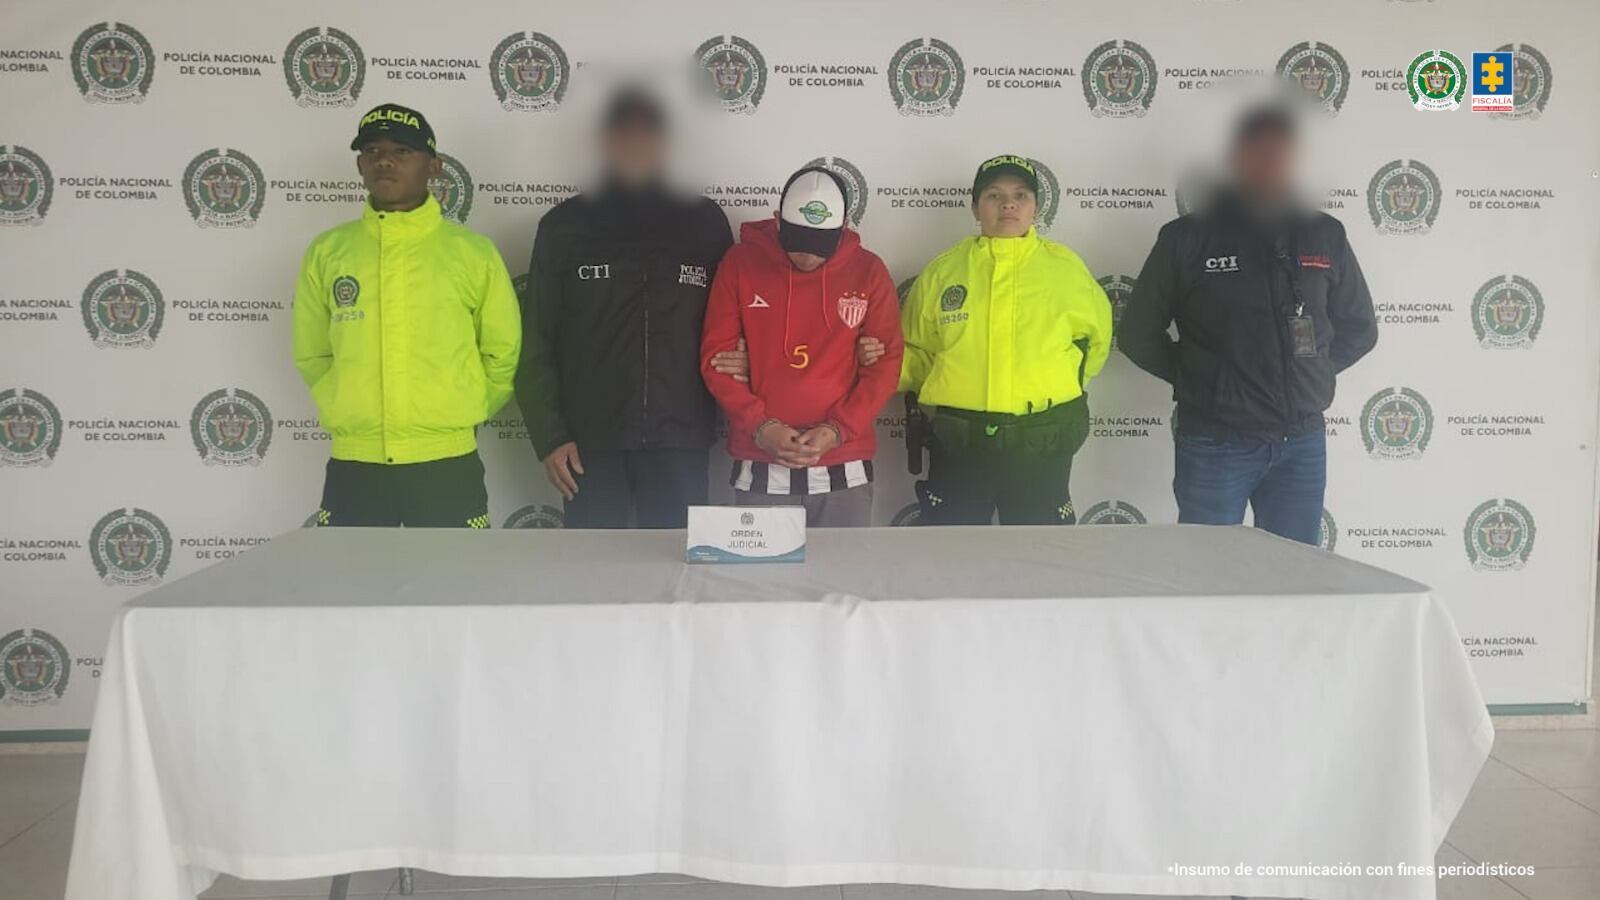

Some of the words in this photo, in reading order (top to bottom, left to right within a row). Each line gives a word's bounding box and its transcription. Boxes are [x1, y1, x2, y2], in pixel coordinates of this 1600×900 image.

[1, 50, 64, 60] NACIONAL
[164, 52, 210, 62] POLICÍA
[214, 54, 276, 64] NACIONAL
[371, 56, 416, 68] POLICÍA
[420, 58, 481, 69] NACIONAL
[0, 63, 49, 72] LOMBIA
[180, 66, 195, 75] DE
[198, 66, 261, 76] COLOMBIA
[774, 64, 817, 74] POLICÍA
[820, 65, 879, 75] NACIONAL
[973, 65, 1016, 76] POLICÍA
[1019, 67, 1076, 76] NACIONAL
[1165, 66, 1208, 77] POLICÍA
[387, 71, 402, 80] DE
[405, 71, 466, 80] COLOMBIA
[1362, 68, 1403, 78] POLICÍA
[789, 78, 803, 86] DE
[806, 78, 864, 87] COLOMBIA
[987, 80, 1001, 88] DE
[1004, 80, 1062, 88] COLOMBIA
[1179, 80, 1192, 90] DE
[1376, 82, 1388, 90] DE
[361, 110, 420, 130] POLICÍA
[60, 174, 106, 187] POLICÍA
[110, 177, 173, 188] NACIONAL
[271, 180, 316, 190] POLICÍA
[478, 182, 524, 192] POLICÍA
[726, 186, 782, 196] NACIONAL
[877, 184, 920, 196] POLICÍA
[1066, 186, 1108, 196] POLICÍA
[1112, 188, 1168, 197] NACIONAL
[76, 190, 92, 200] DE
[94, 190, 157, 200] COLOMBIA
[1329, 188, 1359, 197] ONAL
[1456, 187, 1497, 198] POLICÍA
[1500, 188, 1555, 198] NACIONAL
[286, 193, 301, 202] DE
[306, 193, 366, 202] COLOMBIA
[494, 196, 509, 204] DE
[892, 200, 906, 208] DE
[908, 200, 966, 208] COLOMBIA
[1081, 200, 1094, 208] DE
[1097, 200, 1154, 209] COLOMBIA
[1469, 200, 1482, 210] DE
[1486, 200, 1540, 210] COLOMBIA
[1206, 256, 1238, 268] CTI
[578, 264, 610, 280] CTI
[10, 299, 73, 308] NACIONAL
[172, 298, 220, 309] POLICÍA
[222, 300, 284, 310] NACIONAL
[1398, 303, 1454, 312] NACIONAL
[188, 312, 204, 322] DE
[208, 312, 270, 322] COLOMBIA
[1384, 315, 1440, 324] COLOMBIA
[790, 344, 809, 369] 5
[68, 418, 115, 429] POLICÍA
[119, 420, 181, 429] NACIONAL
[1108, 418, 1164, 426] NACIONAL
[1448, 414, 1489, 424] POLICÍA
[1492, 416, 1545, 425] NACIONAL
[294, 432, 309, 440] DE
[498, 432, 513, 440] DE
[890, 430, 905, 438] DE
[1093, 430, 1149, 438] COLOMBIA
[1460, 428, 1474, 436] DE
[1477, 427, 1532, 436] COLOMBIA
[84, 432, 100, 441] DE
[103, 432, 166, 441] COLOMBIA
[730, 530, 763, 538] ORDEN
[1348, 526, 1388, 537] POLICÍA
[1392, 528, 1447, 537] NACIONAL
[19, 540, 82, 548] NACIONAL
[180, 536, 226, 547] POLICÍA
[728, 540, 768, 548] JUDICIAL
[1362, 540, 1375, 548] DE
[1378, 540, 1432, 548] COLOMBIA
[4, 552, 66, 561] COLOMBIA
[196, 550, 210, 559] DE
[1484, 637, 1538, 646] NACIONAL
[1470, 648, 1524, 657] COLOMBIA
